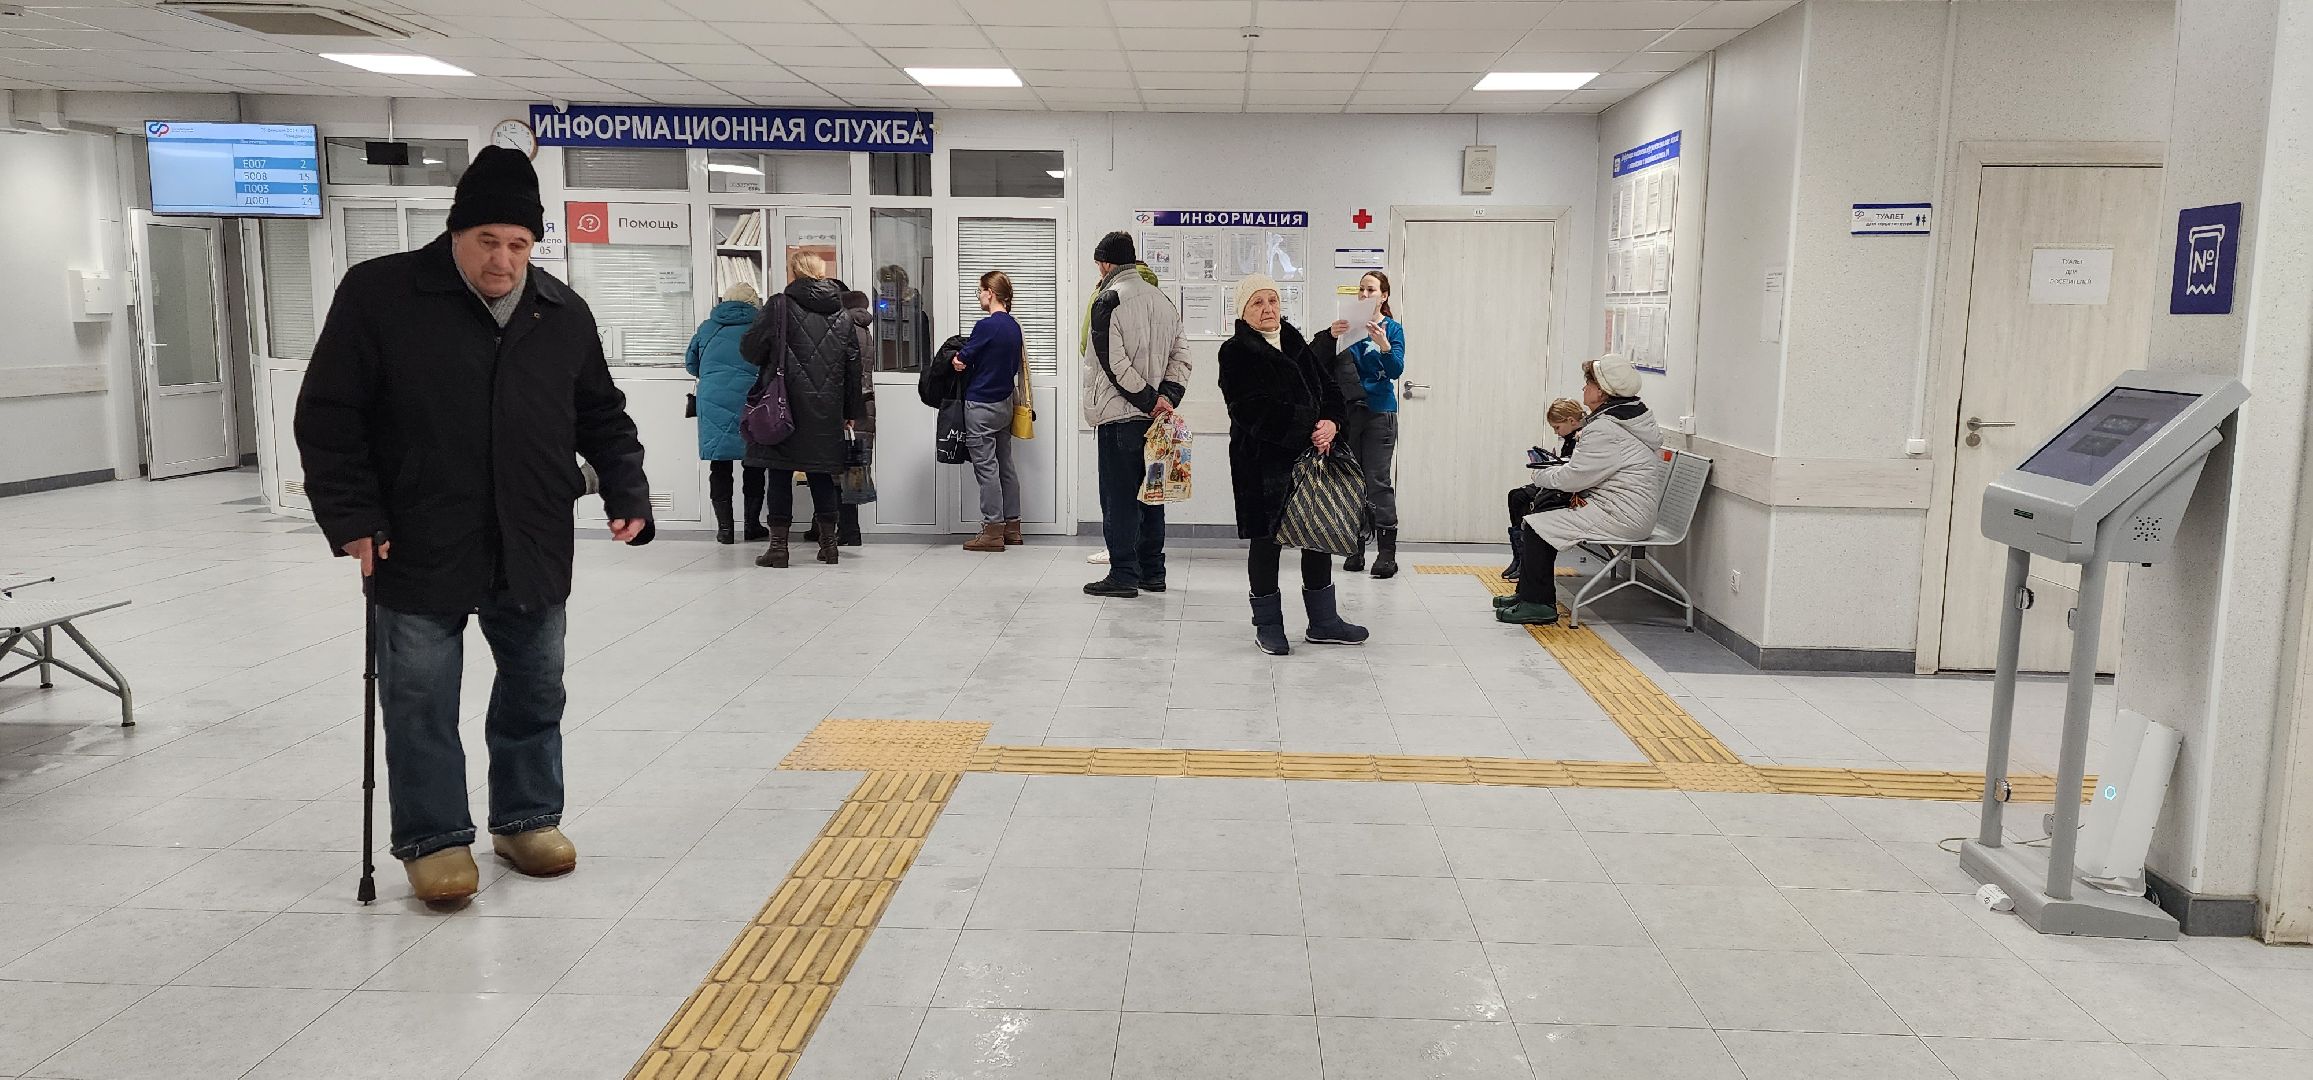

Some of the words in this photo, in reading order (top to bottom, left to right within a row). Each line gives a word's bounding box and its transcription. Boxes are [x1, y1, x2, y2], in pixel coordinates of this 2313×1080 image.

[534, 113, 806, 145] ИНФОРМАЦИОННАЯ
[814, 118, 929, 145] СЛУЖБА
[300, 159, 306, 169] 2
[302, 184, 309, 193] 5
[618, 217, 678, 230] Помощь
[1180, 212, 1303, 227] ИНФОРМАЦИЯ
[539, 246, 551, 255] 05
